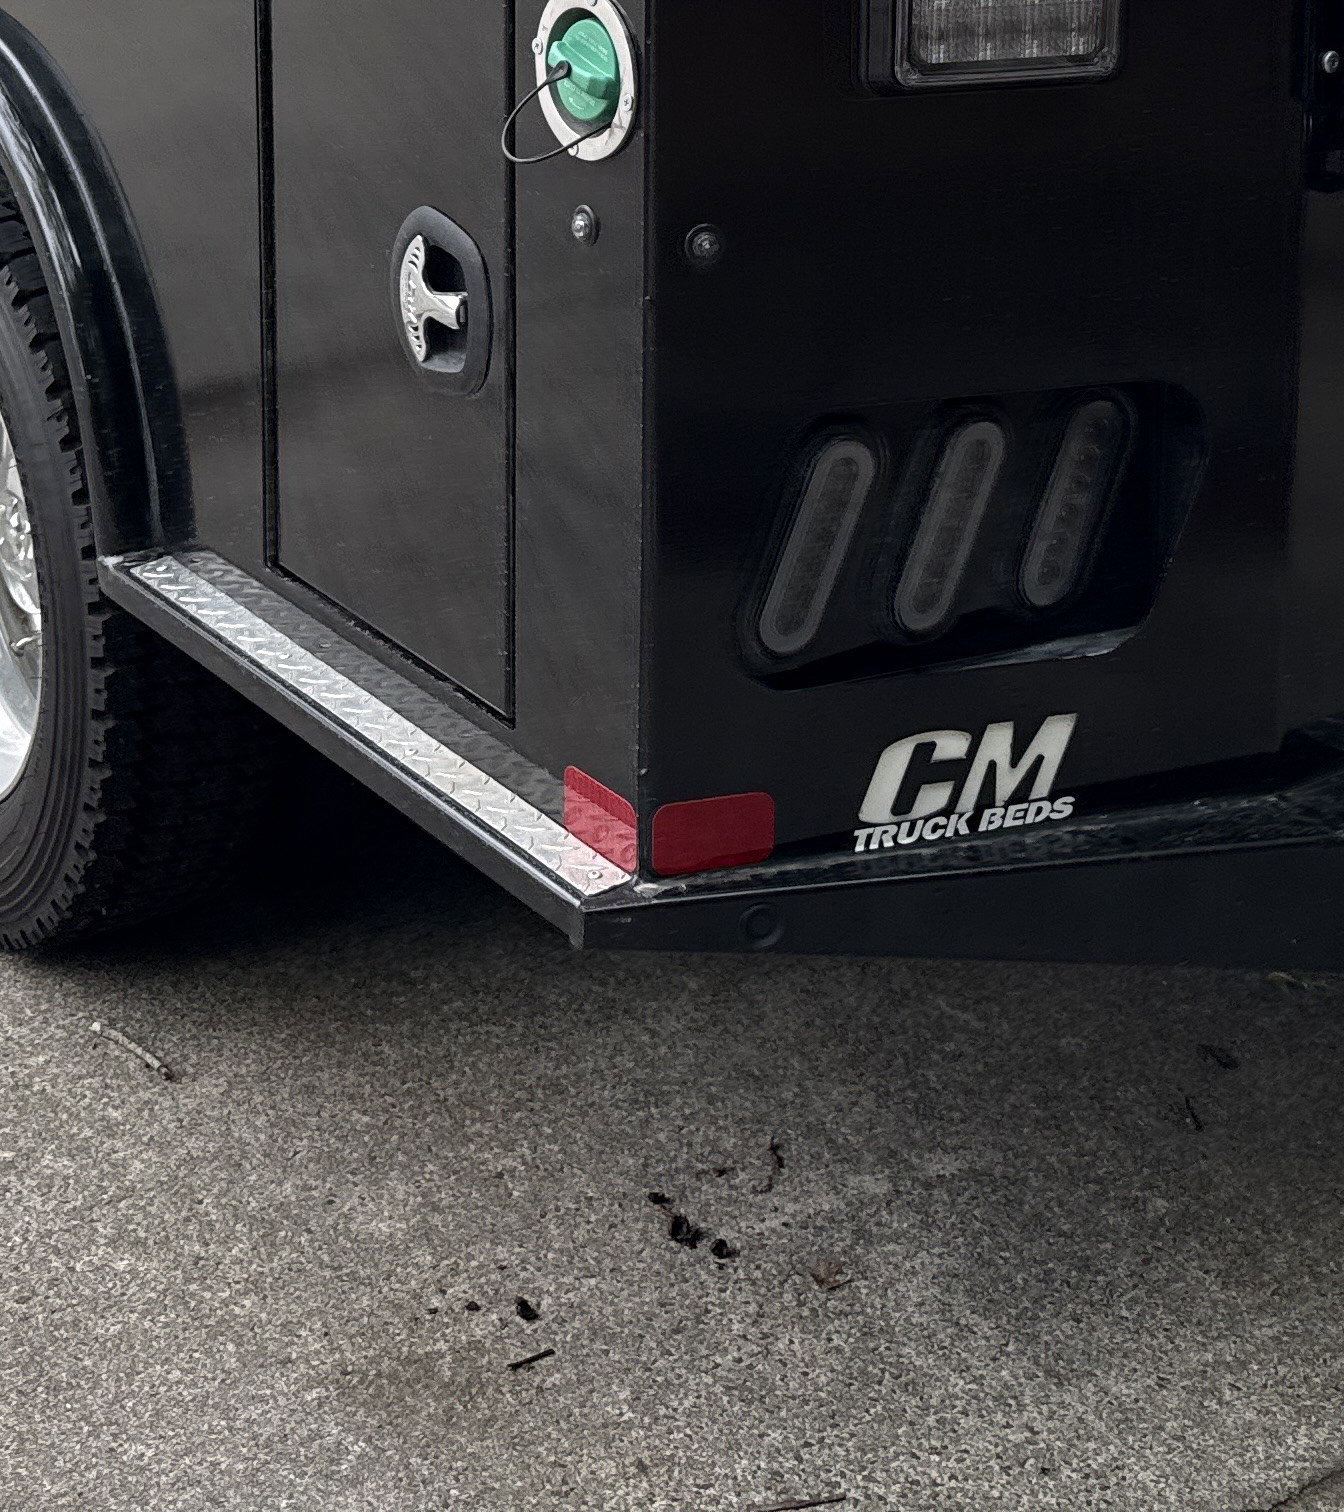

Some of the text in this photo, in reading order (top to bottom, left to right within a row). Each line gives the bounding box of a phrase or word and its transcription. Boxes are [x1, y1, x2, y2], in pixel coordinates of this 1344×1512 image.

[858, 712, 1078, 824] CM
[853, 795, 1076, 853] TRUCK BEDS
